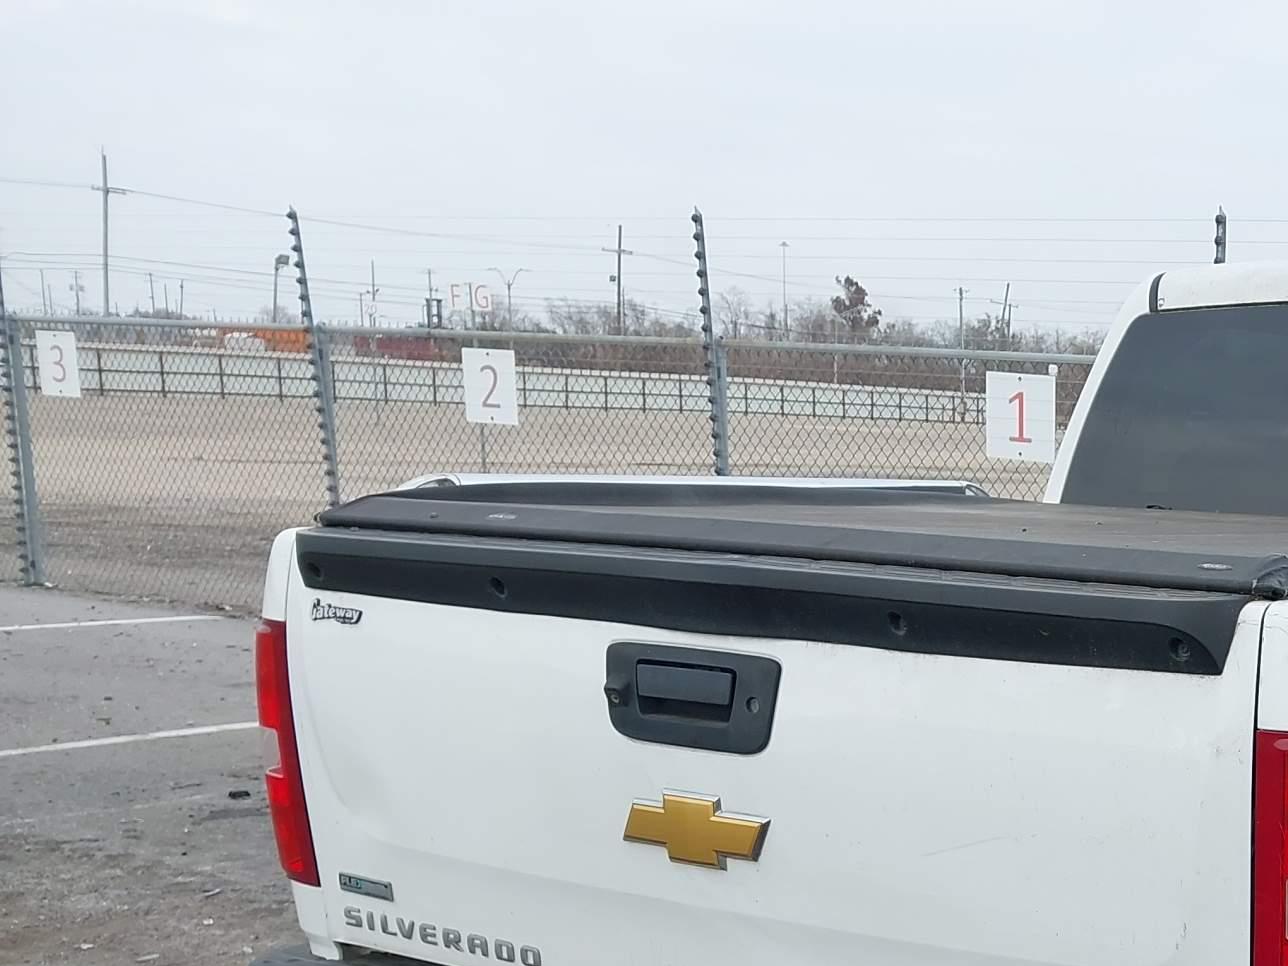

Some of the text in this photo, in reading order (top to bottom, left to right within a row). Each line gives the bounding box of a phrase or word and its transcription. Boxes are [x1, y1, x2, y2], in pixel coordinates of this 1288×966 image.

[450, 283, 461, 308] F
[474, 284, 489, 309] G
[49, 344, 66, 383] 3
[480, 364, 501, 408] 2
[1008, 391, 1033, 443] 1
